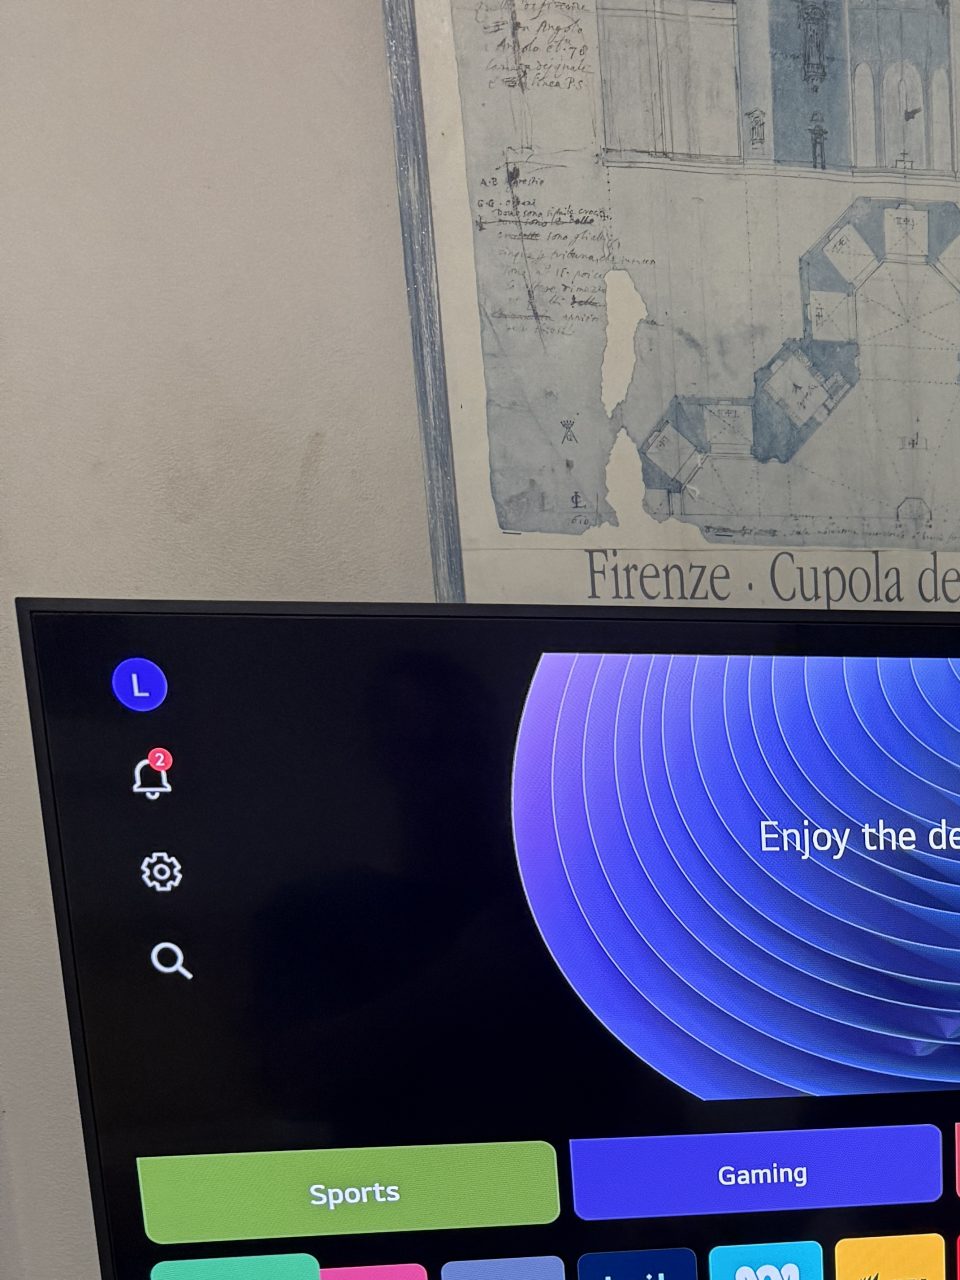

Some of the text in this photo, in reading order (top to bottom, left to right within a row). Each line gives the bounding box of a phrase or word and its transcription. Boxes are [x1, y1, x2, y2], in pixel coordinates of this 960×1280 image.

[585, 549, 732, 601] Firenze
[770, 550, 905, 609] Cupola
[132, 674, 150, 696] L
[154, 753, 166, 767] 2
[759, 820, 850, 860] Enjoy
[861, 820, 917, 852] the
[717, 1162, 808, 1189] Gaming
[309, 1182, 401, 1211] Sports
